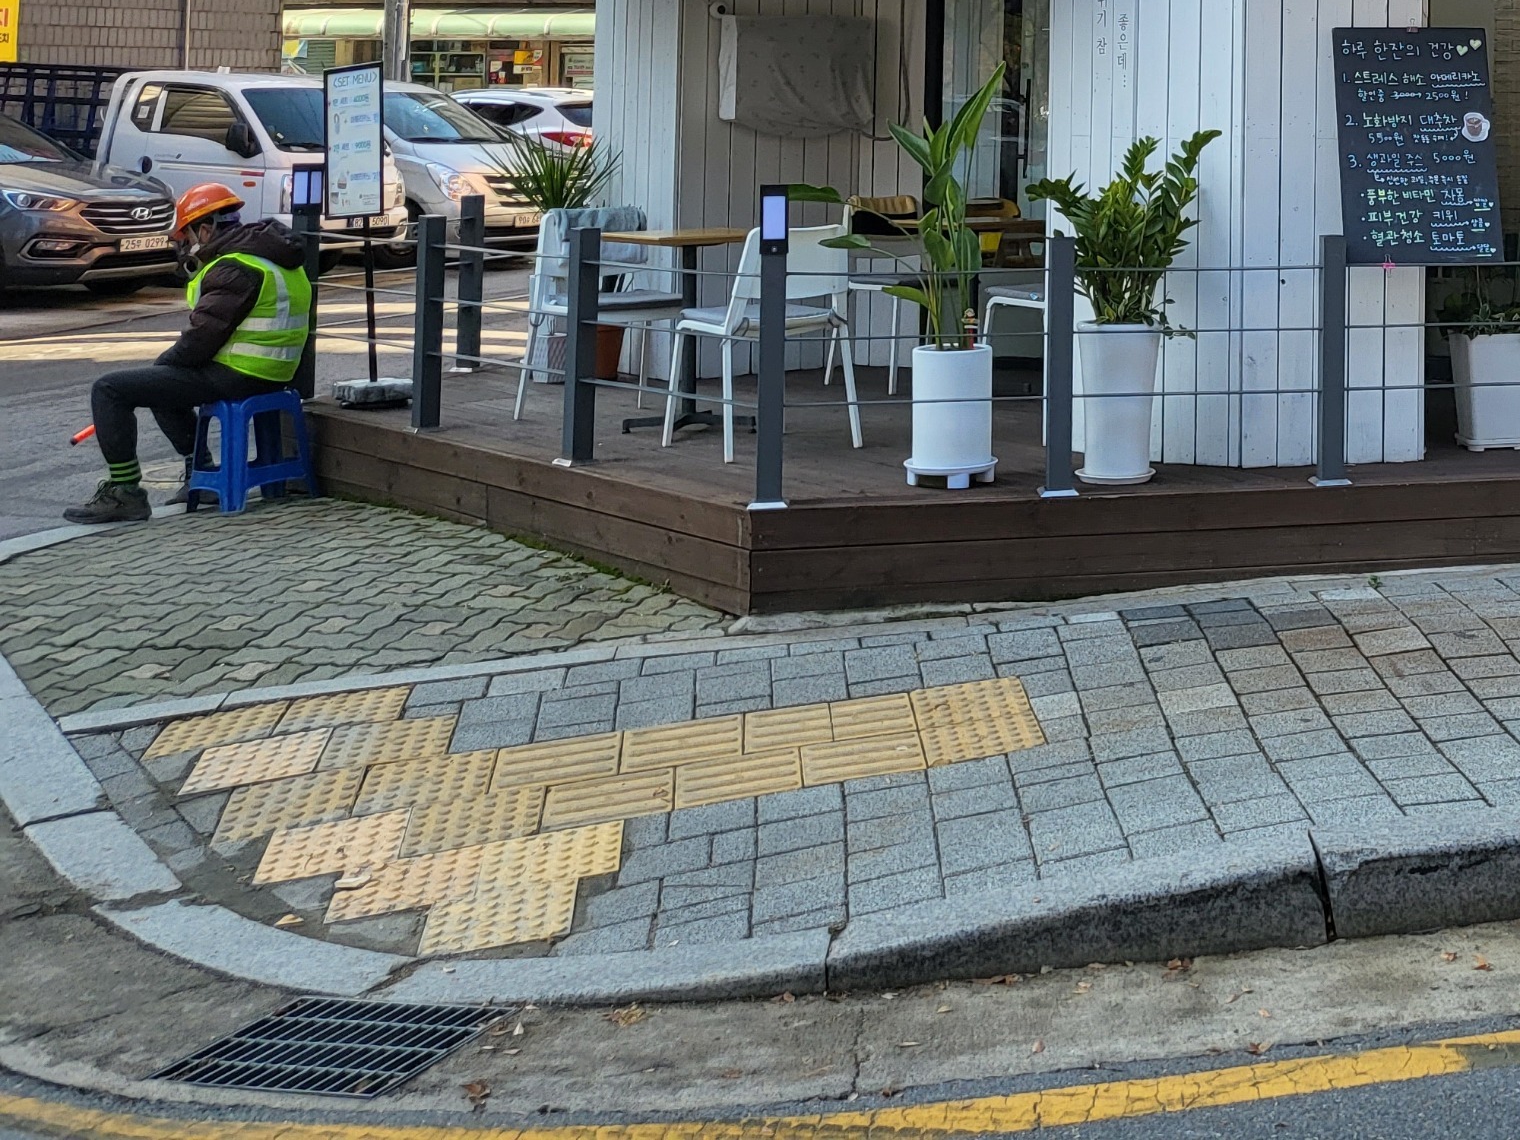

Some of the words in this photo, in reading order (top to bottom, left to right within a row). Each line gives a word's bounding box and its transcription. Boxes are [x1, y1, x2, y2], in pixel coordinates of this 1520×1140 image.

[1096, 37, 1108, 55] 참
[1341, 39, 1367, 59] 하루
[1374, 39, 1420, 61] 한잔의
[1428, 42, 1454, 60] 건강
[1343, 73, 1351, 83] 1.
[1354, 71, 1399, 85] 스트레스
[1402, 72, 1427, 85] 해소
[1430, 70, 1481, 83] 아메리카노
[1425, 89, 1461, 102] 2500원
[1345, 114, 1359, 126] 2.
[1362, 112, 1412, 128] 노화방지
[1420, 111, 1458, 128] 대추차
[1368, 131, 1404, 147] 5500원
[1348, 154, 1362, 168] 3.
[1366, 153, 1401, 168] 생과일
[1405, 153, 1423, 166] 주스
[1433, 149, 1476, 164] 5000원
[1366, 188, 1400, 206] 풍부한
[1402, 188, 1436, 203] 비타민
[1440, 187, 1465, 203] 자몽
[1432, 209, 1458, 222] 키위
[1431, 230, 1466, 246] 토마토
